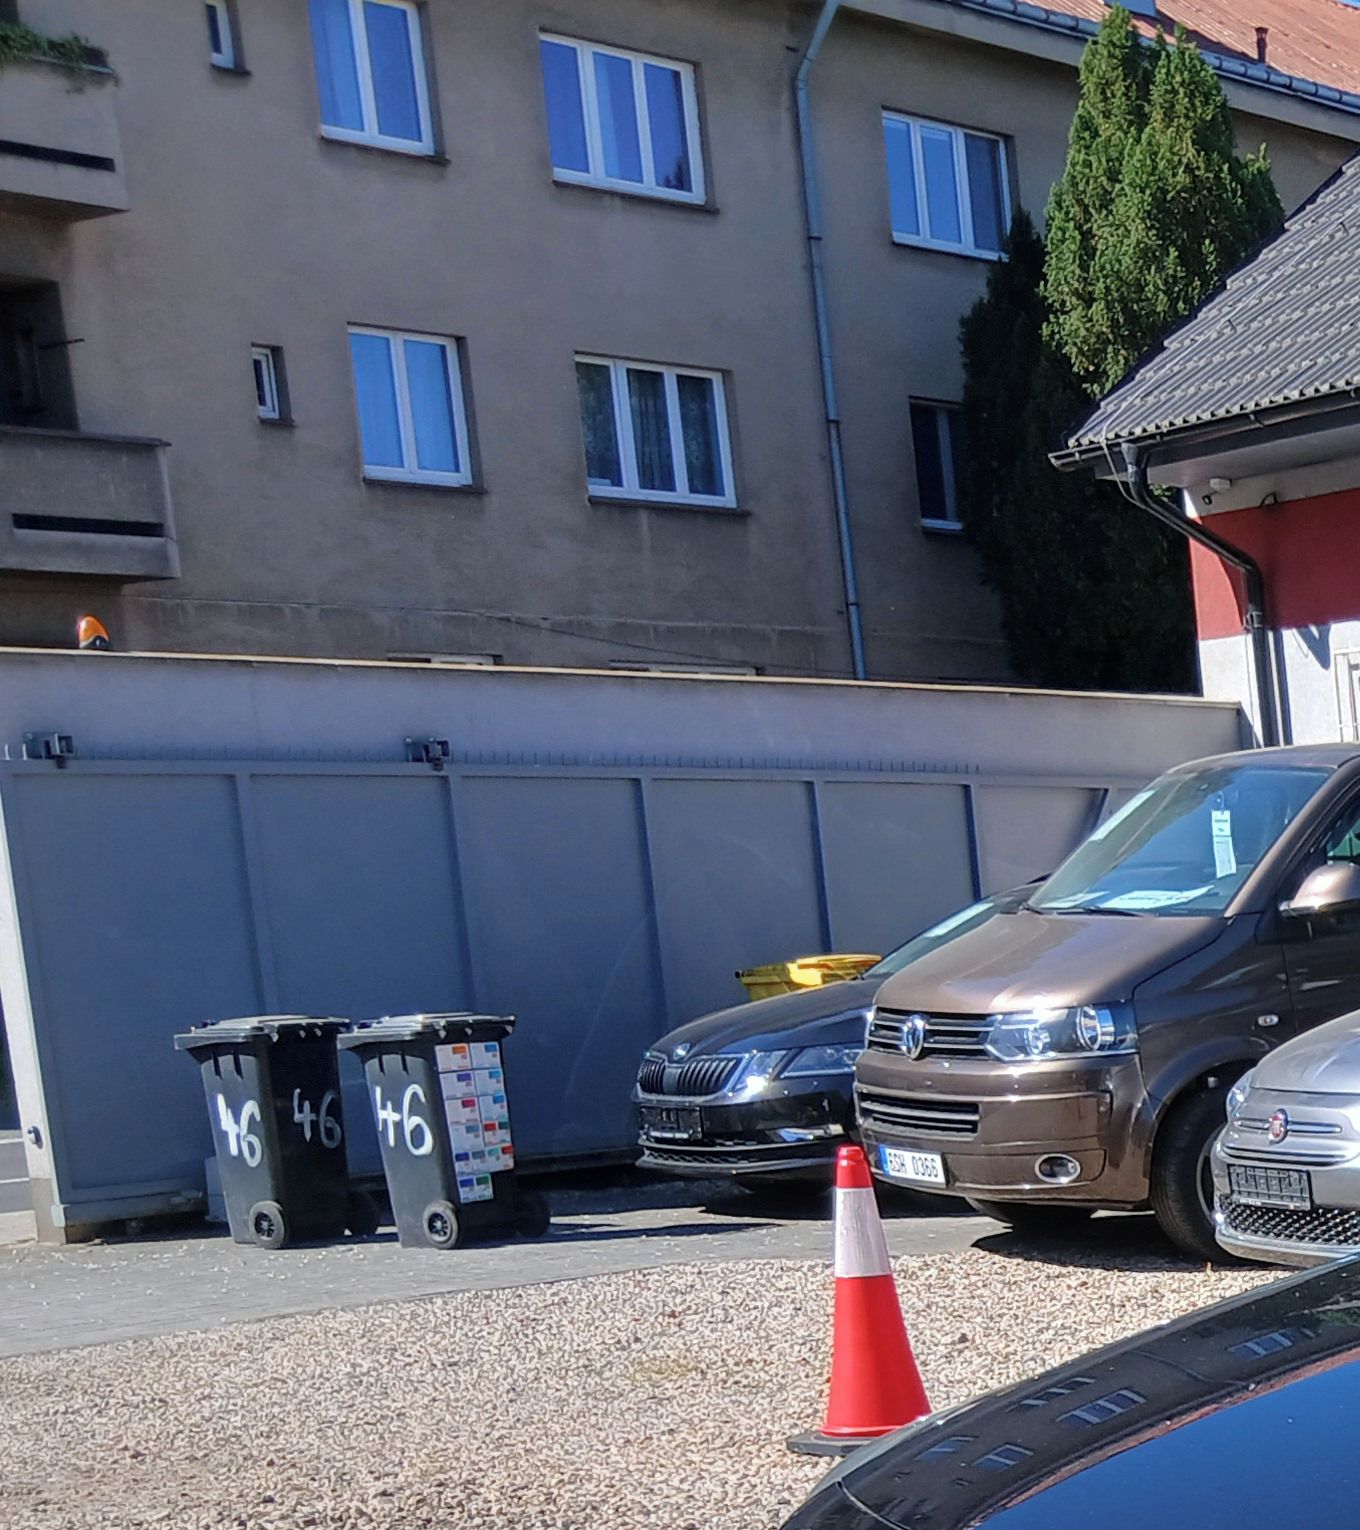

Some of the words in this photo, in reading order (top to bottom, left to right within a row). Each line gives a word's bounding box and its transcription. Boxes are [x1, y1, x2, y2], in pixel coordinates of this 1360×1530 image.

[217, 1093, 263, 1168] 46
[293, 1088, 342, 1149] 46
[375, 1084, 433, 1156] 46
